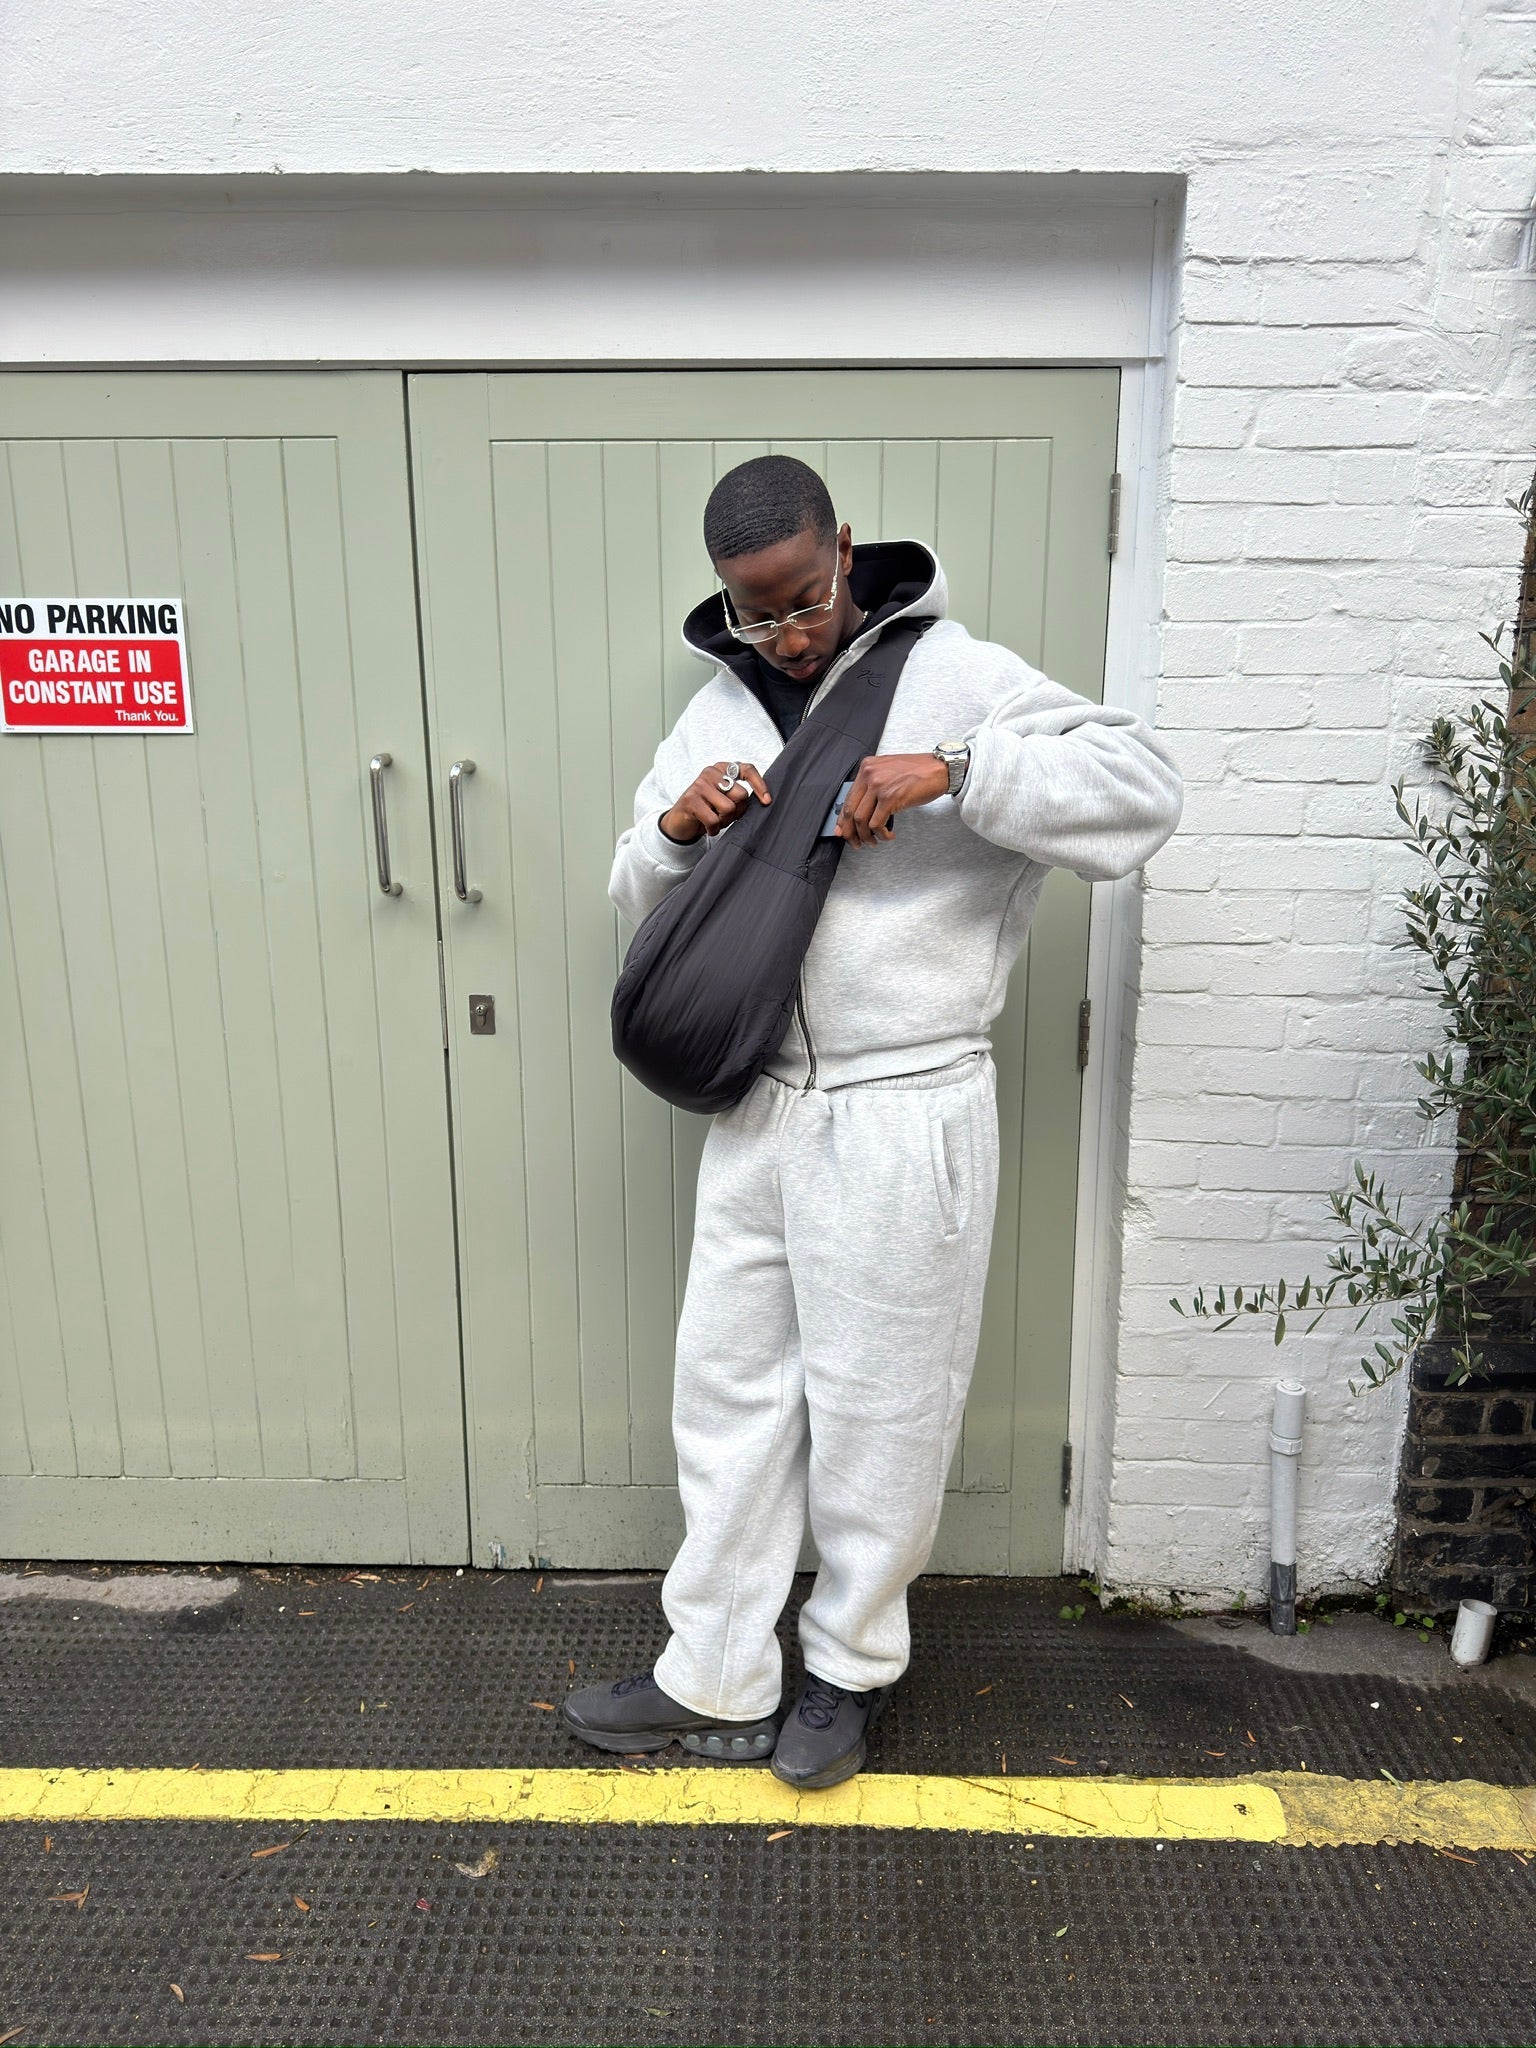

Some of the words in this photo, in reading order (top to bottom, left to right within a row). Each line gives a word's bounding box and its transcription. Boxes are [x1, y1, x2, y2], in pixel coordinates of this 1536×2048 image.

[0, 604, 35, 634] NO
[47, 604, 178, 634] PARKING
[28, 649, 121, 673] GARAGE
[128, 650, 152, 673] IN
[9, 680, 125, 704] CONSTANT
[133, 681, 178, 704] USE
[115, 710, 152, 721] Thank
[154, 710, 179, 722] You.
